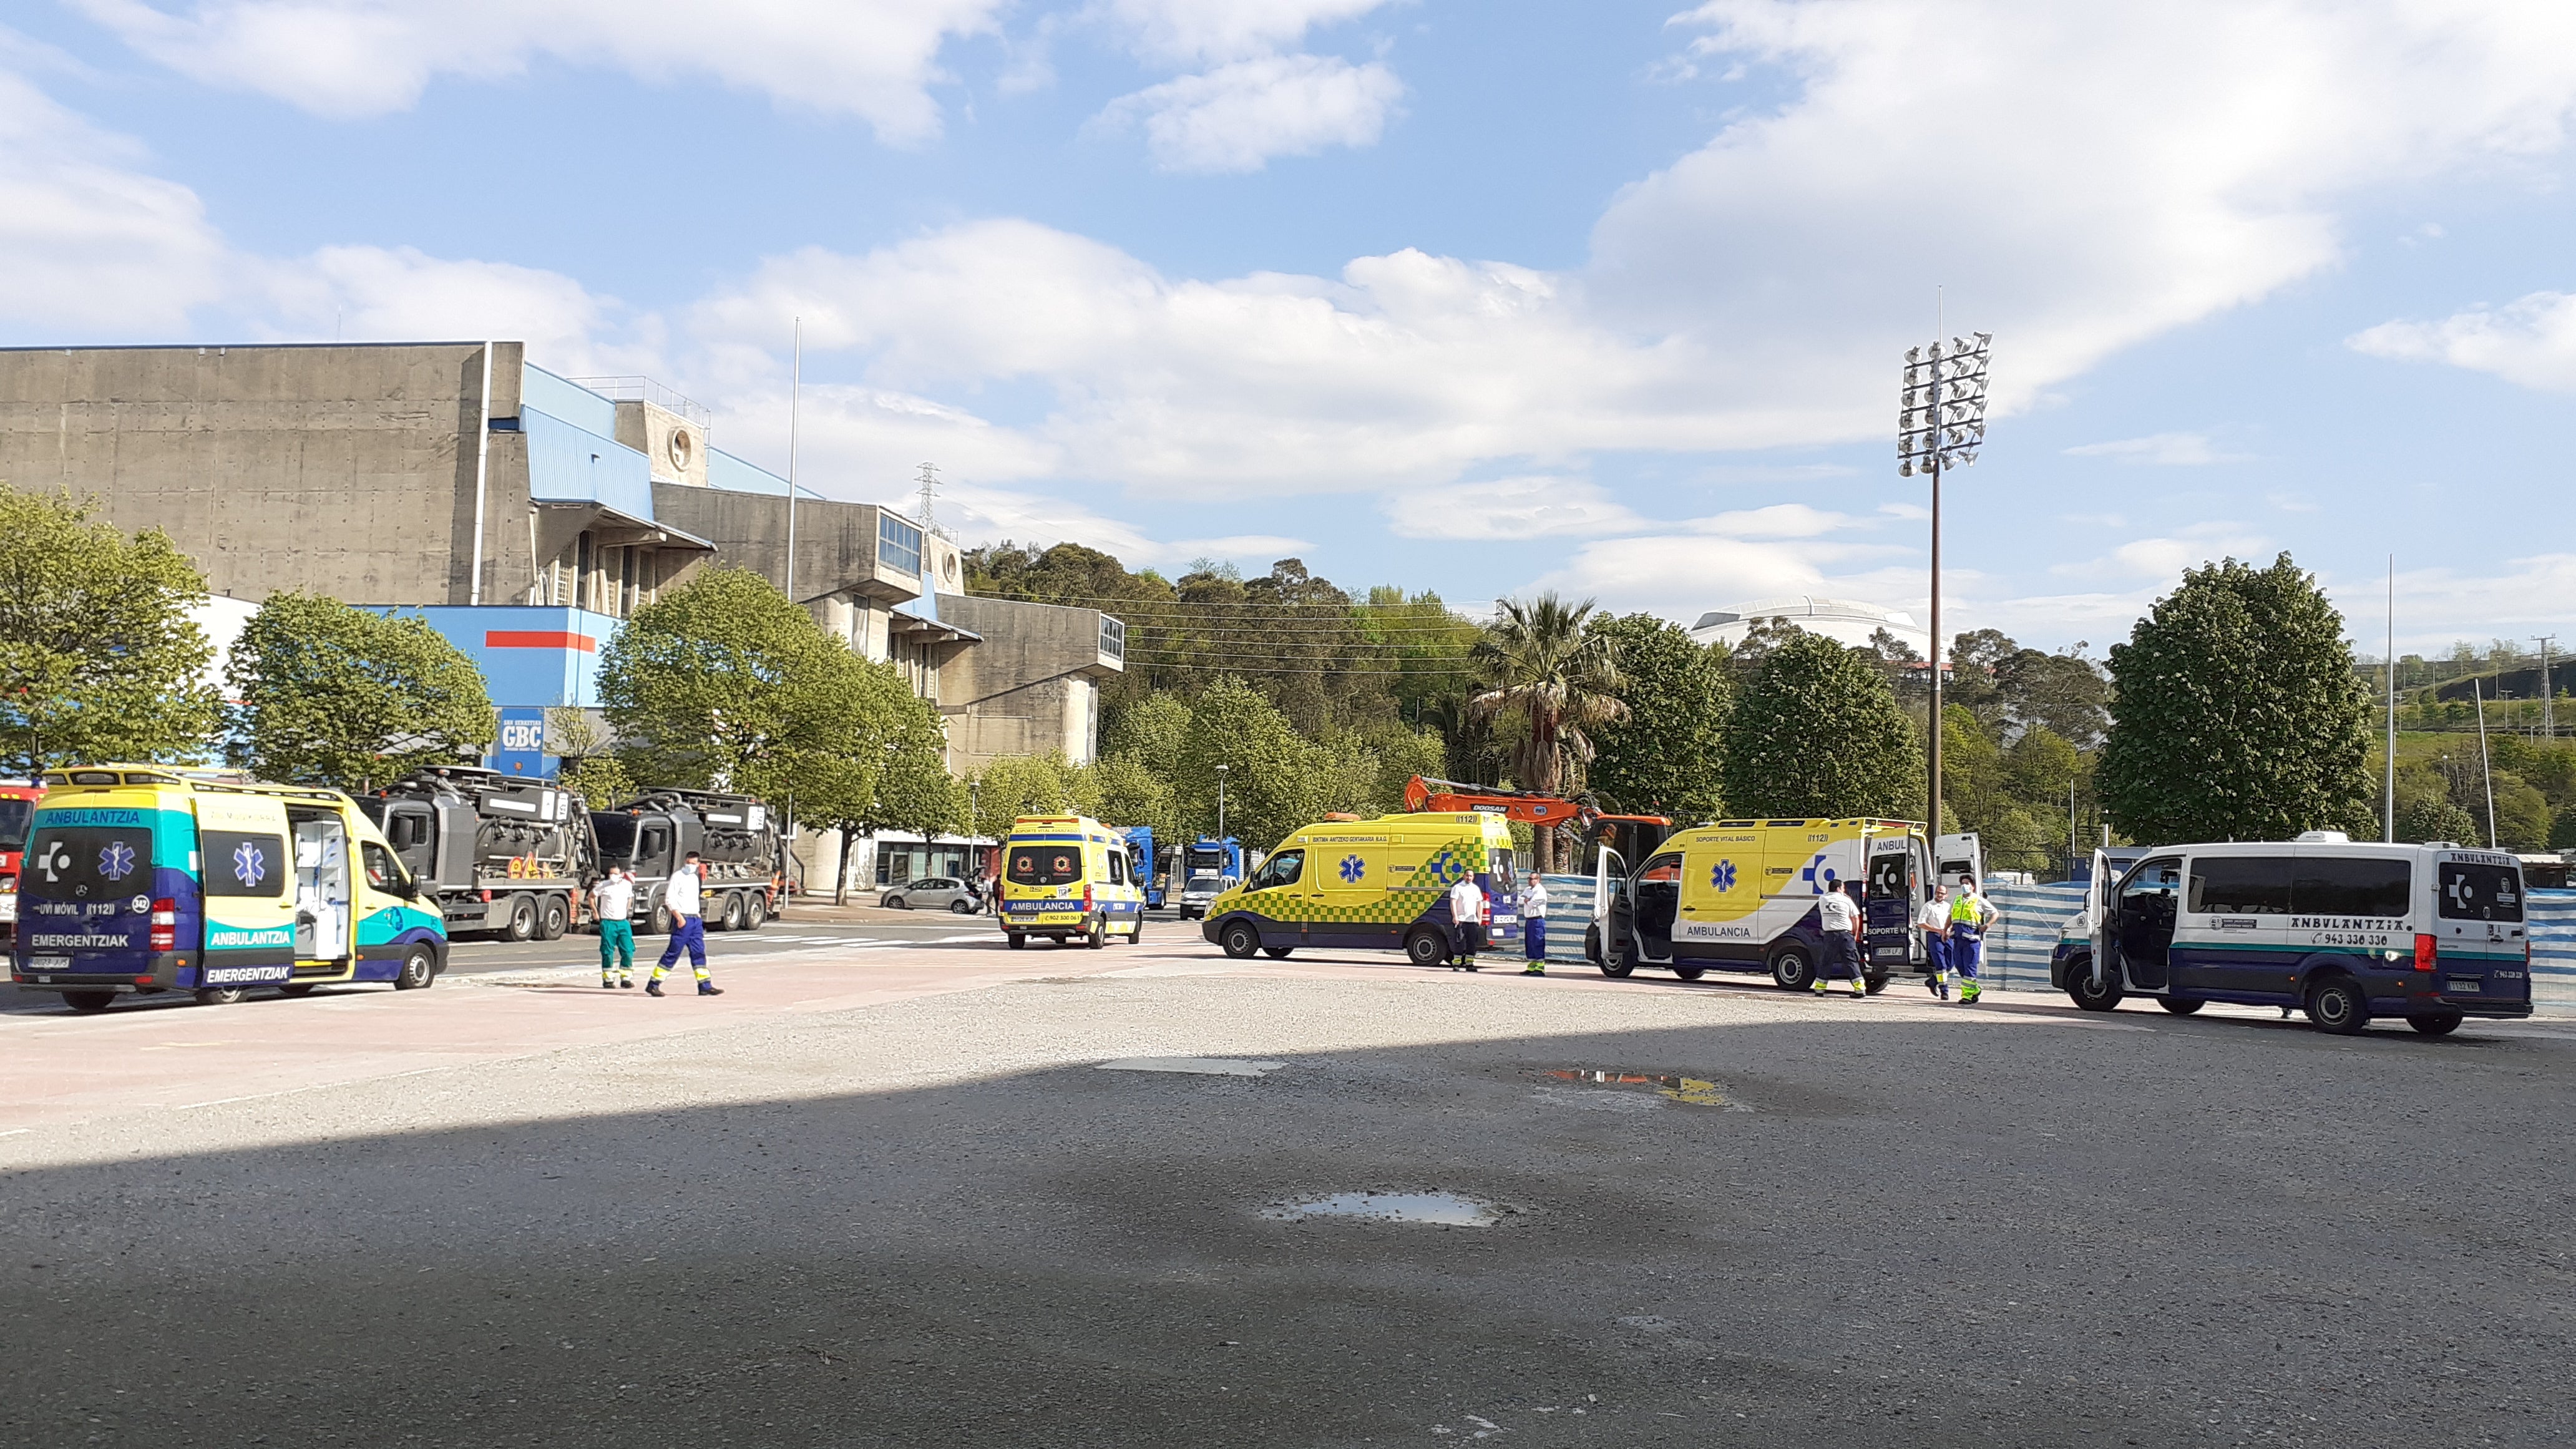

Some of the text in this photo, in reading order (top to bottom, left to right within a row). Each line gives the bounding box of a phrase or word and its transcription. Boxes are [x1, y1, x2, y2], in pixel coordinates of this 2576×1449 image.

[502, 726, 542, 748] GBC
[45, 811, 140, 824] ANBULANTZIA
[1876, 839, 1906, 851] ANBUL
[1011, 902, 1075, 910] AMBULANCIA
[1687, 926, 1750, 937] AMBULANCIA
[1868, 927, 1899, 935] SOPORTE
[32, 935, 129, 947] EMERGENTZIAK
[211, 930, 291, 945] ANBULANTZIA
[2325, 934, 2388, 946] 943 330 330
[207, 967, 289, 983] EMERGENTZIAK
